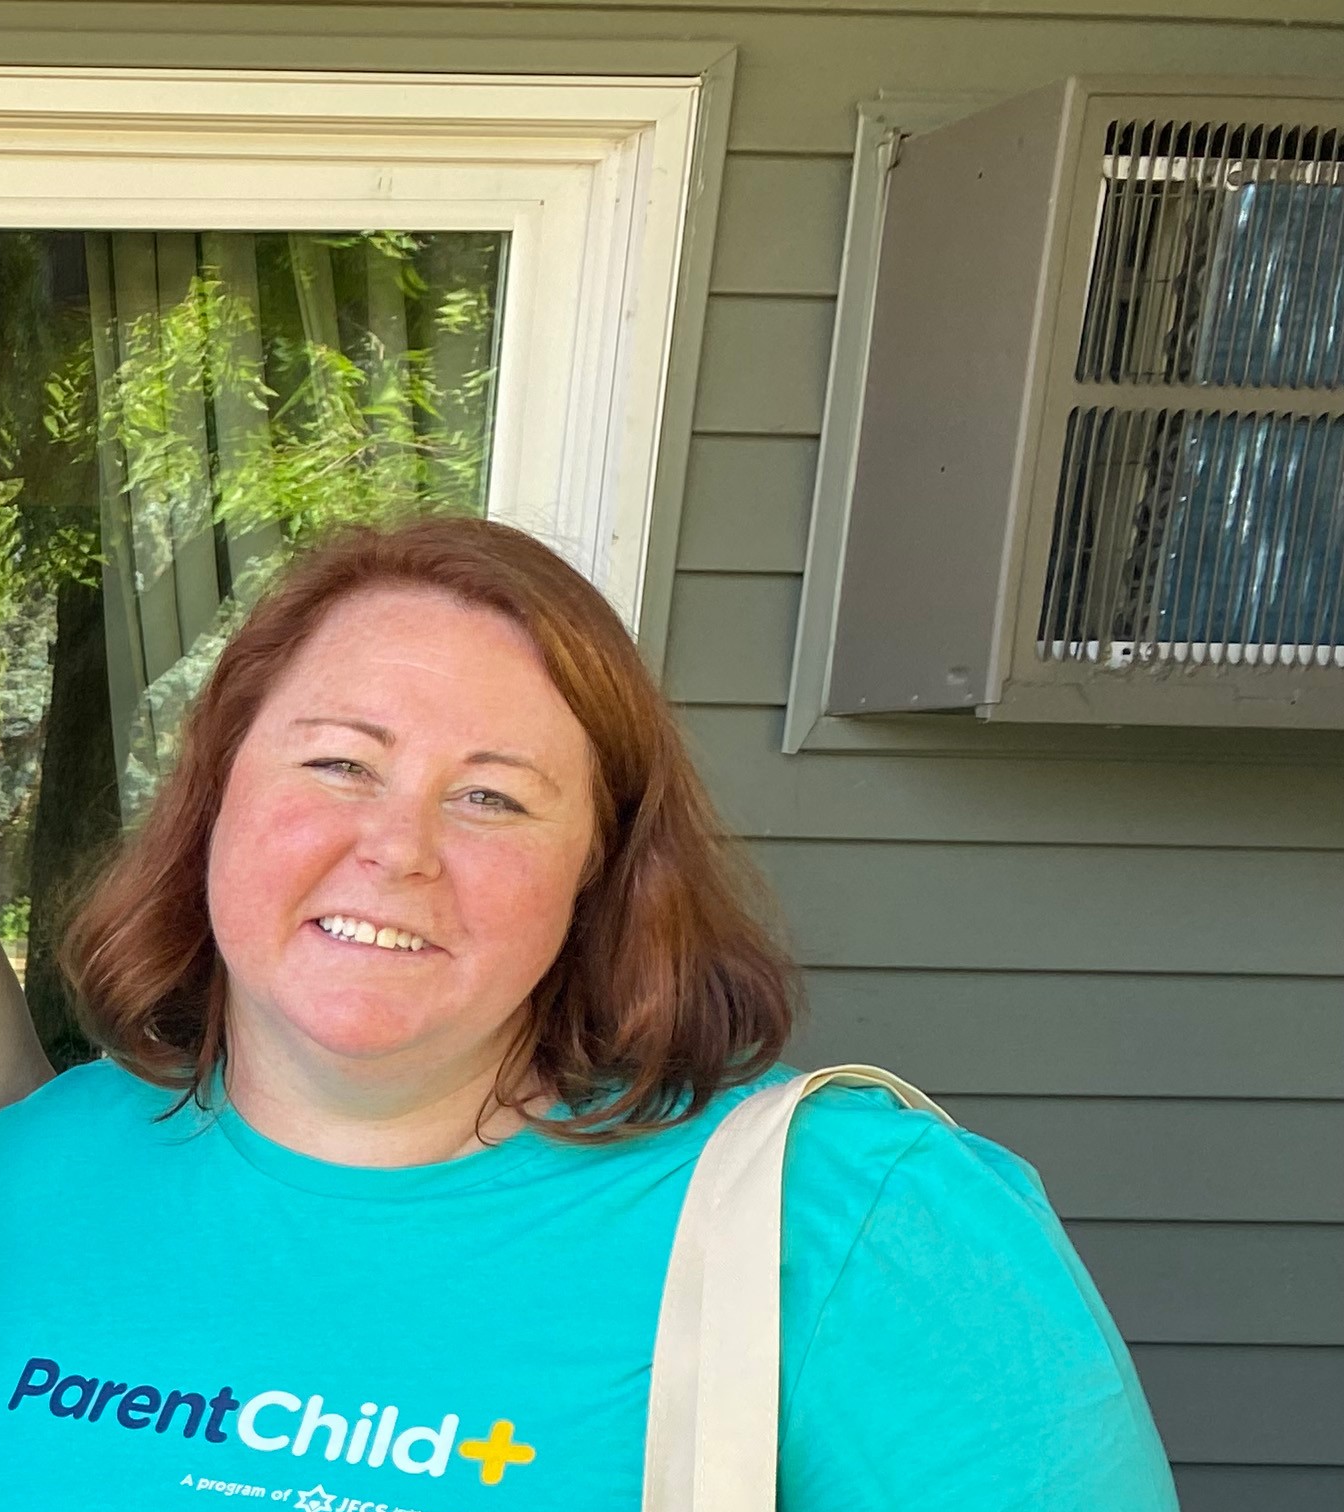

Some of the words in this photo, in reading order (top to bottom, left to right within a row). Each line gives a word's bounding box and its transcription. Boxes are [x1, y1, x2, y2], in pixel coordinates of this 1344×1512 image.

[179, 1473, 194, 1487] A
[196, 1477, 266, 1498] program
[270, 1488, 293, 1502] of
